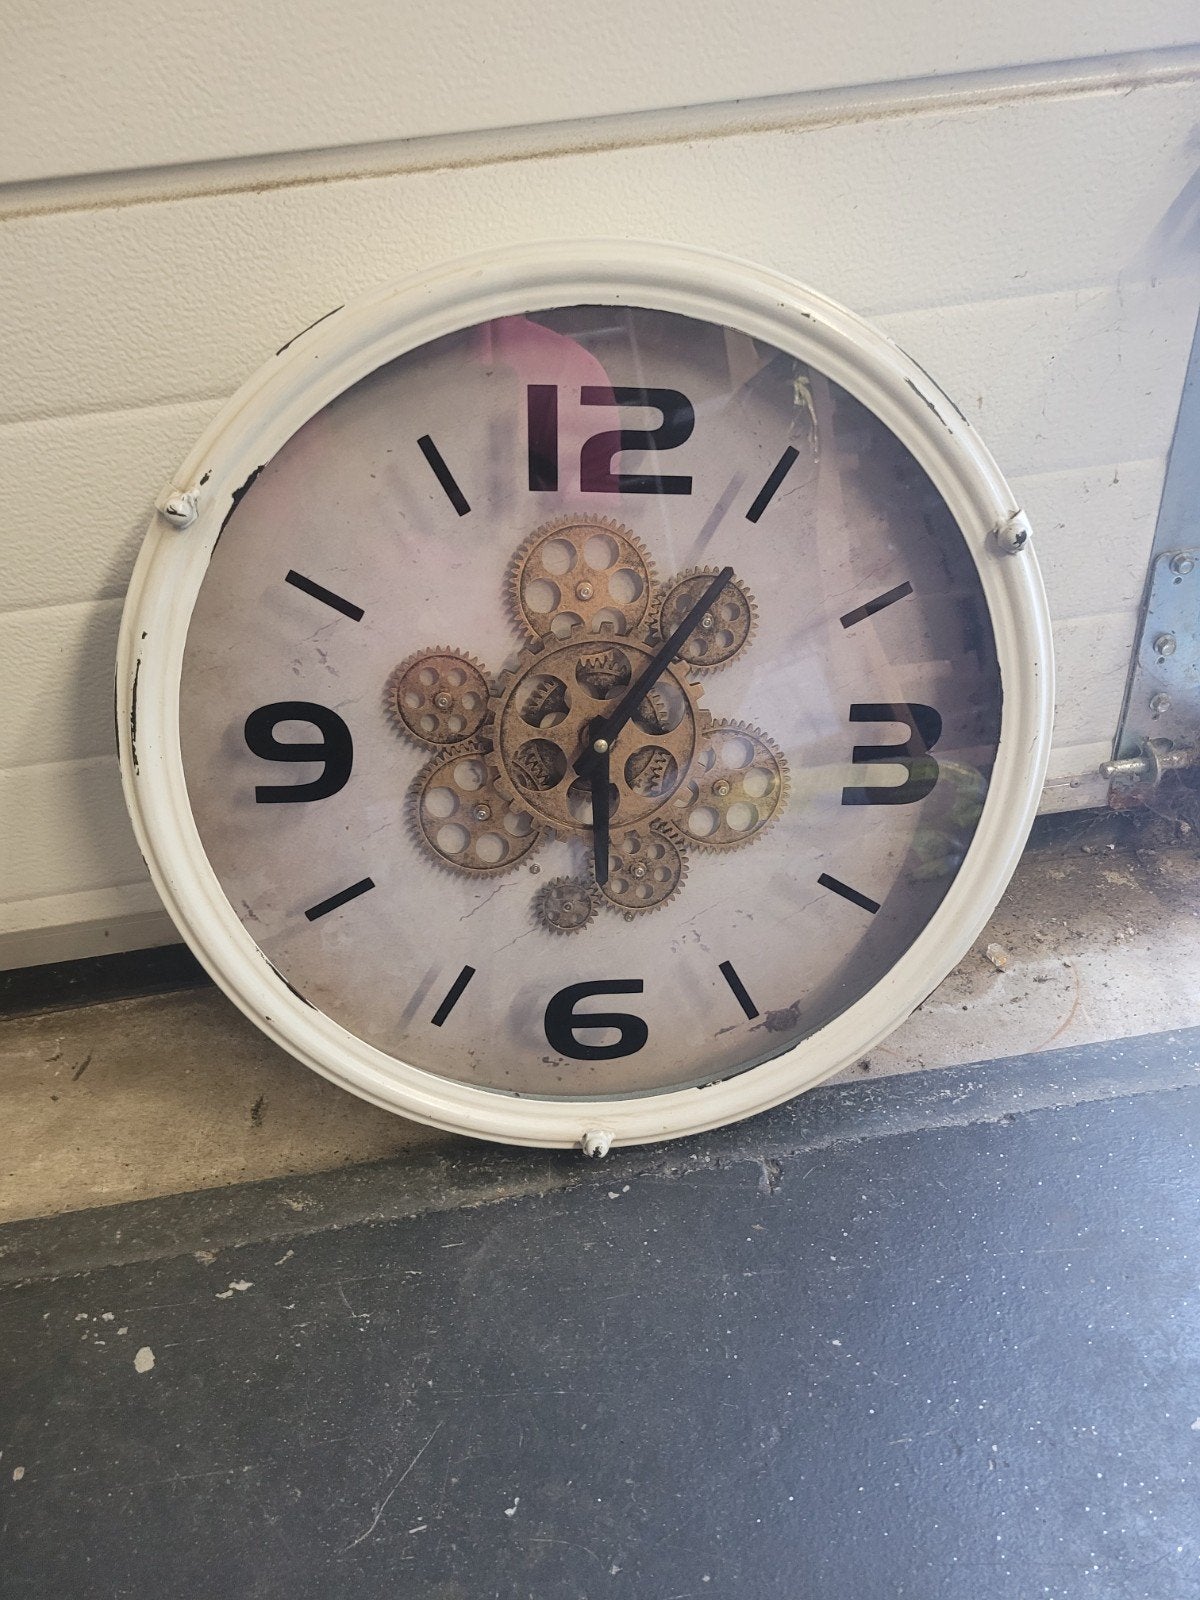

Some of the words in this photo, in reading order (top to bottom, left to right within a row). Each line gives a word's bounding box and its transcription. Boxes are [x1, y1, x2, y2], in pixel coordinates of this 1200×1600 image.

[528, 385, 695, 495] 12
[244, 701, 354, 804] 9
[842, 703, 942, 806] 3
[544, 979, 649, 1060] 6
